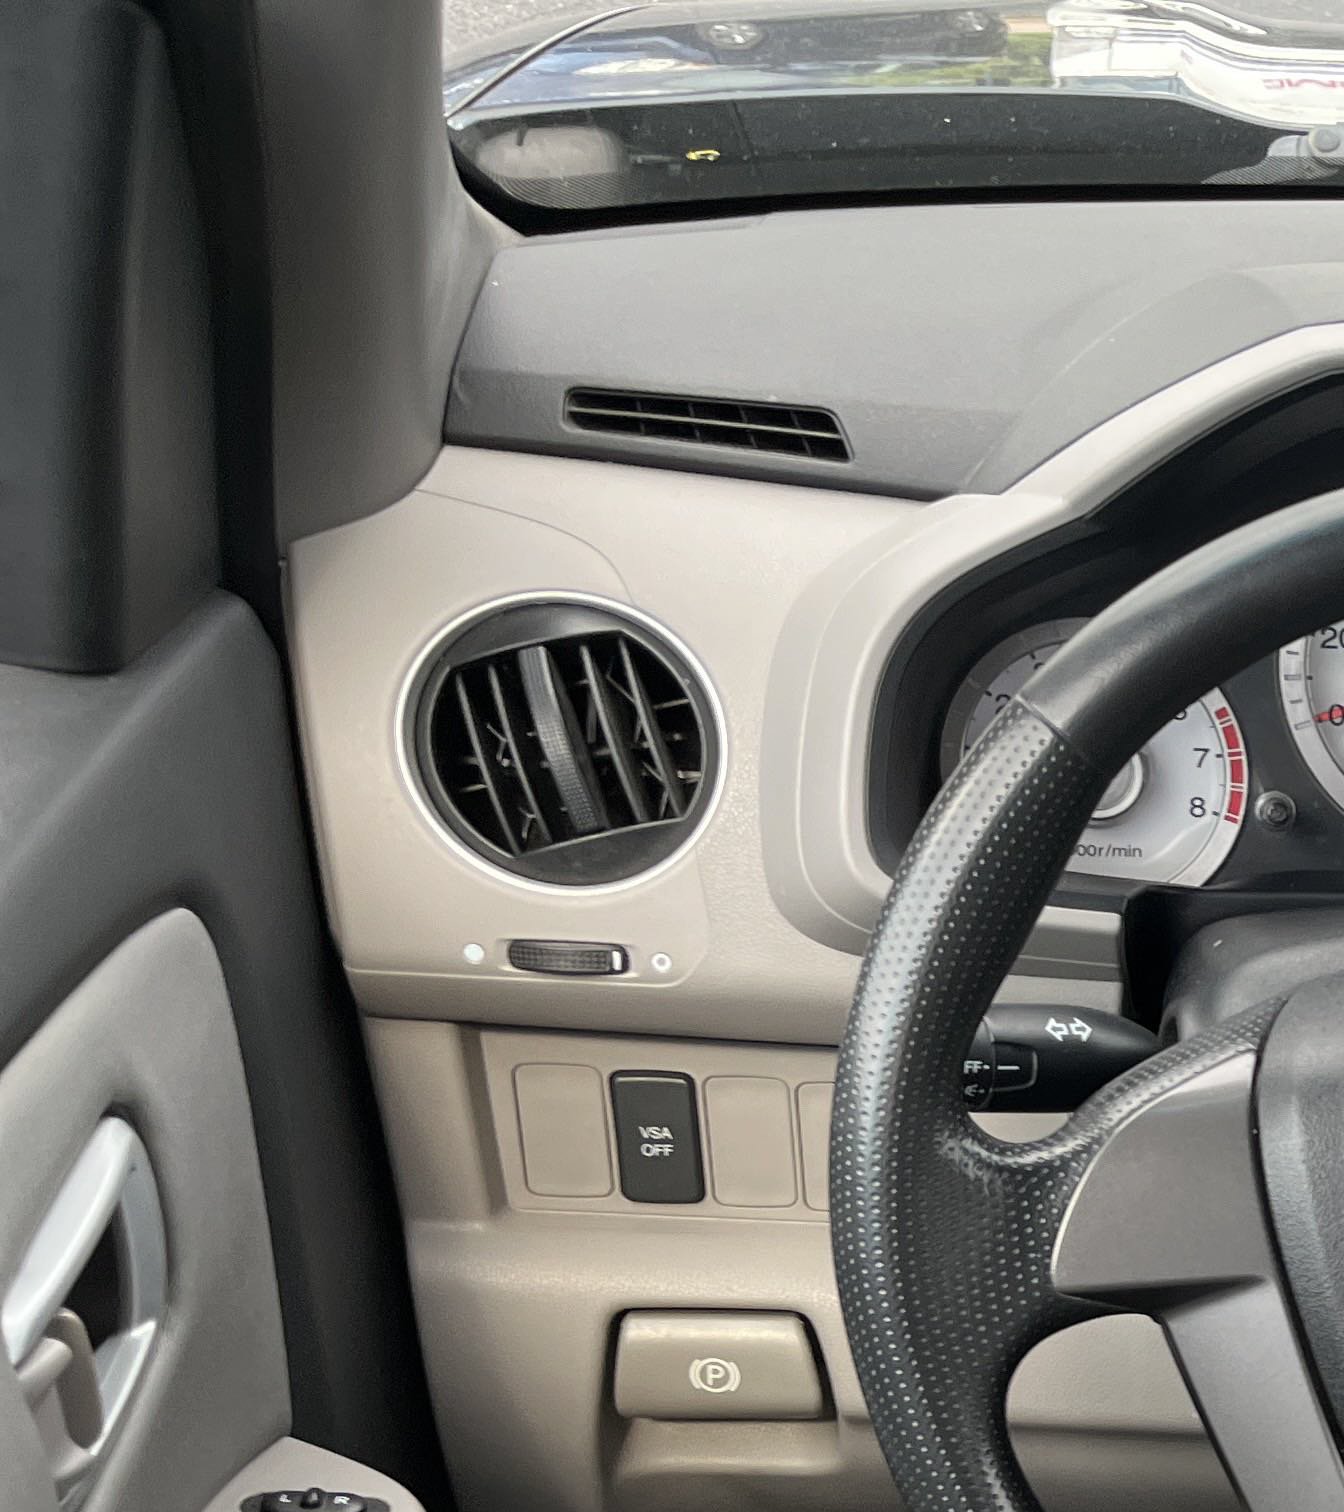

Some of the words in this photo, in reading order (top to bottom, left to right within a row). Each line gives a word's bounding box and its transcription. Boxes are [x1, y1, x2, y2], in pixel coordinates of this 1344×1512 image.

[1193, 748, 1210, 768] 7
[1190, 797, 1206, 818] 8
[1075, 845, 1143, 858] 00r/min
[638, 1126, 673, 1141] VSA
[640, 1143, 674, 1158] OFF
